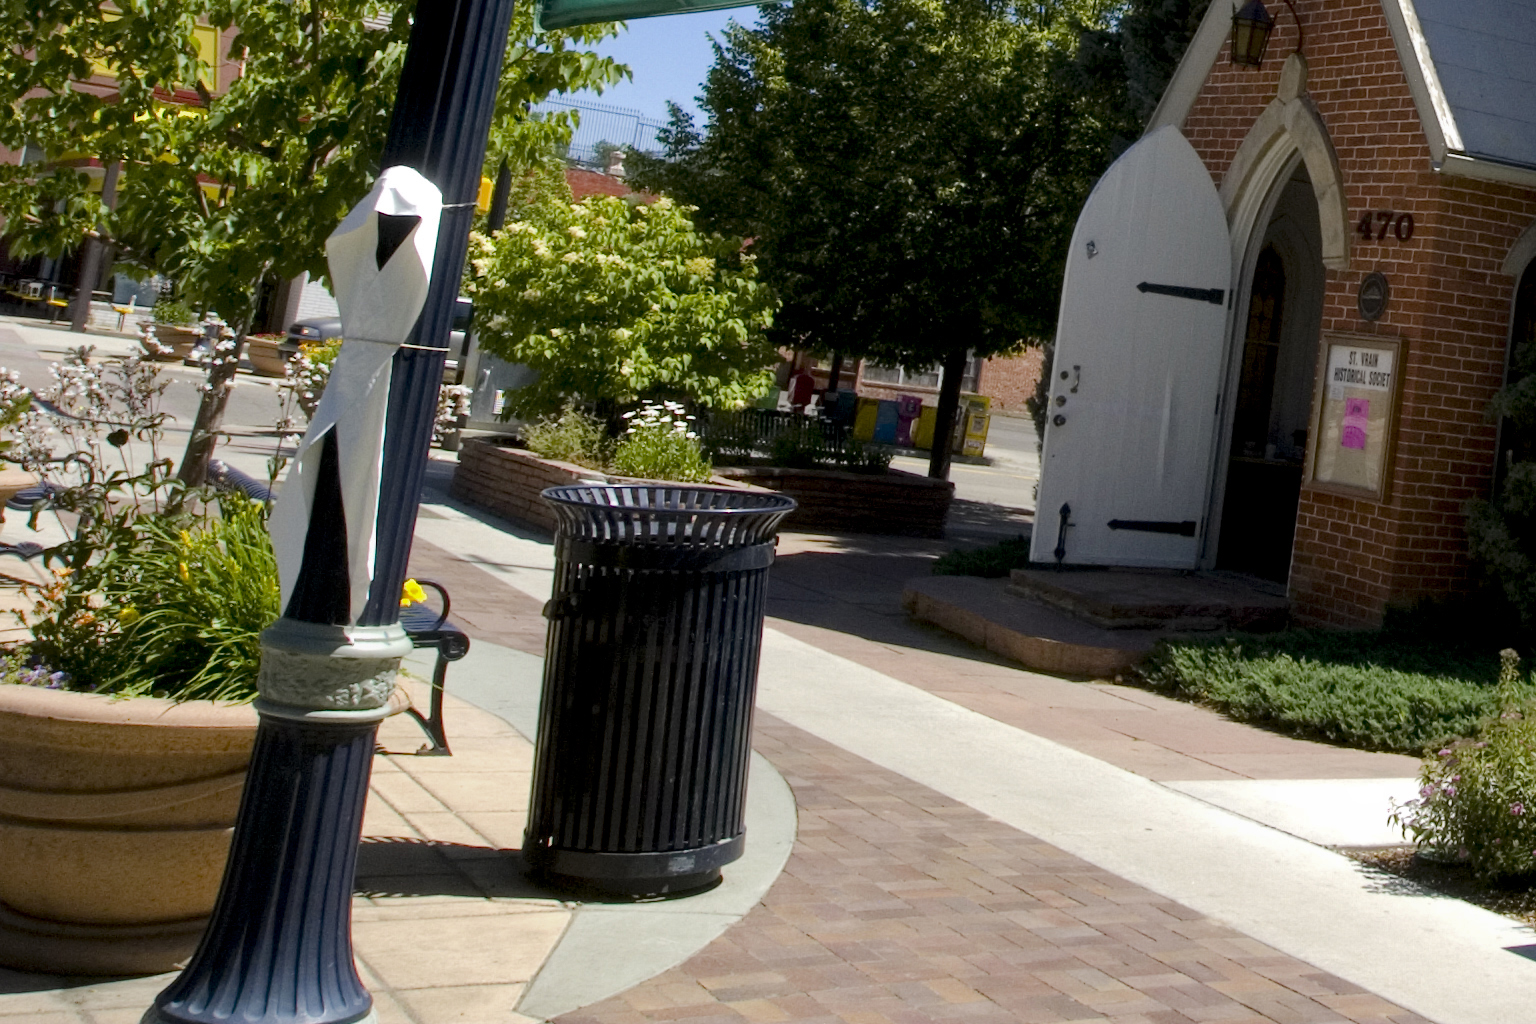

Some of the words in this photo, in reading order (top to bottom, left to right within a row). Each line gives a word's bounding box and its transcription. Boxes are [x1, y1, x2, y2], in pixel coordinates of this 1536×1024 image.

[1357, 210, 1414, 242] 470
[1361, 352, 1379, 367] VRAIN
[1334, 367, 1366, 384] HISTORICAL
[1369, 371, 1390, 387] SOCIET
